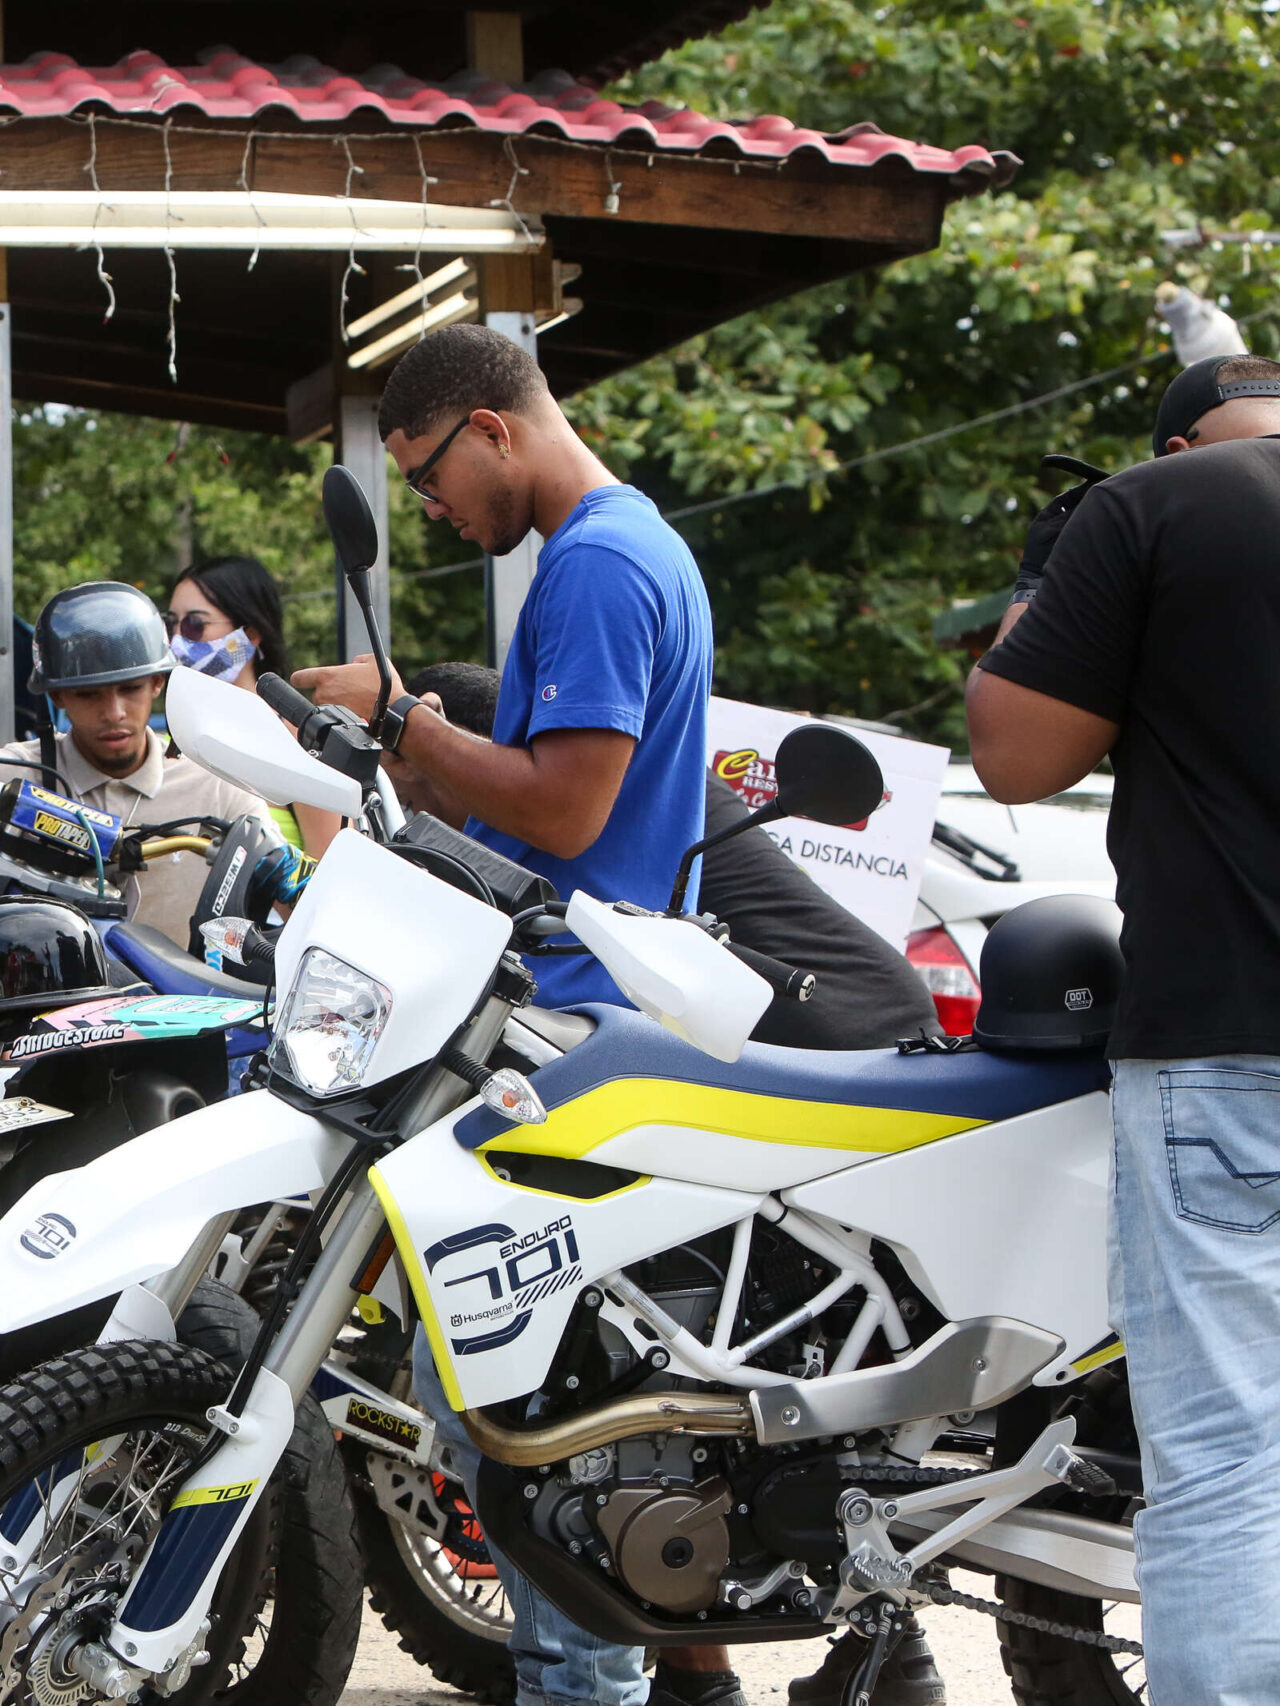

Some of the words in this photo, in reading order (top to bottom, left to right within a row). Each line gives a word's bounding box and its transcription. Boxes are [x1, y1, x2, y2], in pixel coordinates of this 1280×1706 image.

[800, 839, 909, 879] DISTANCIA
[11, 1021, 132, 1059] BRIDGESTONE
[499, 1214, 573, 1259] ENDURO
[463, 1301, 513, 1324] Husqvarna
[207, 1483, 253, 1501] 701
